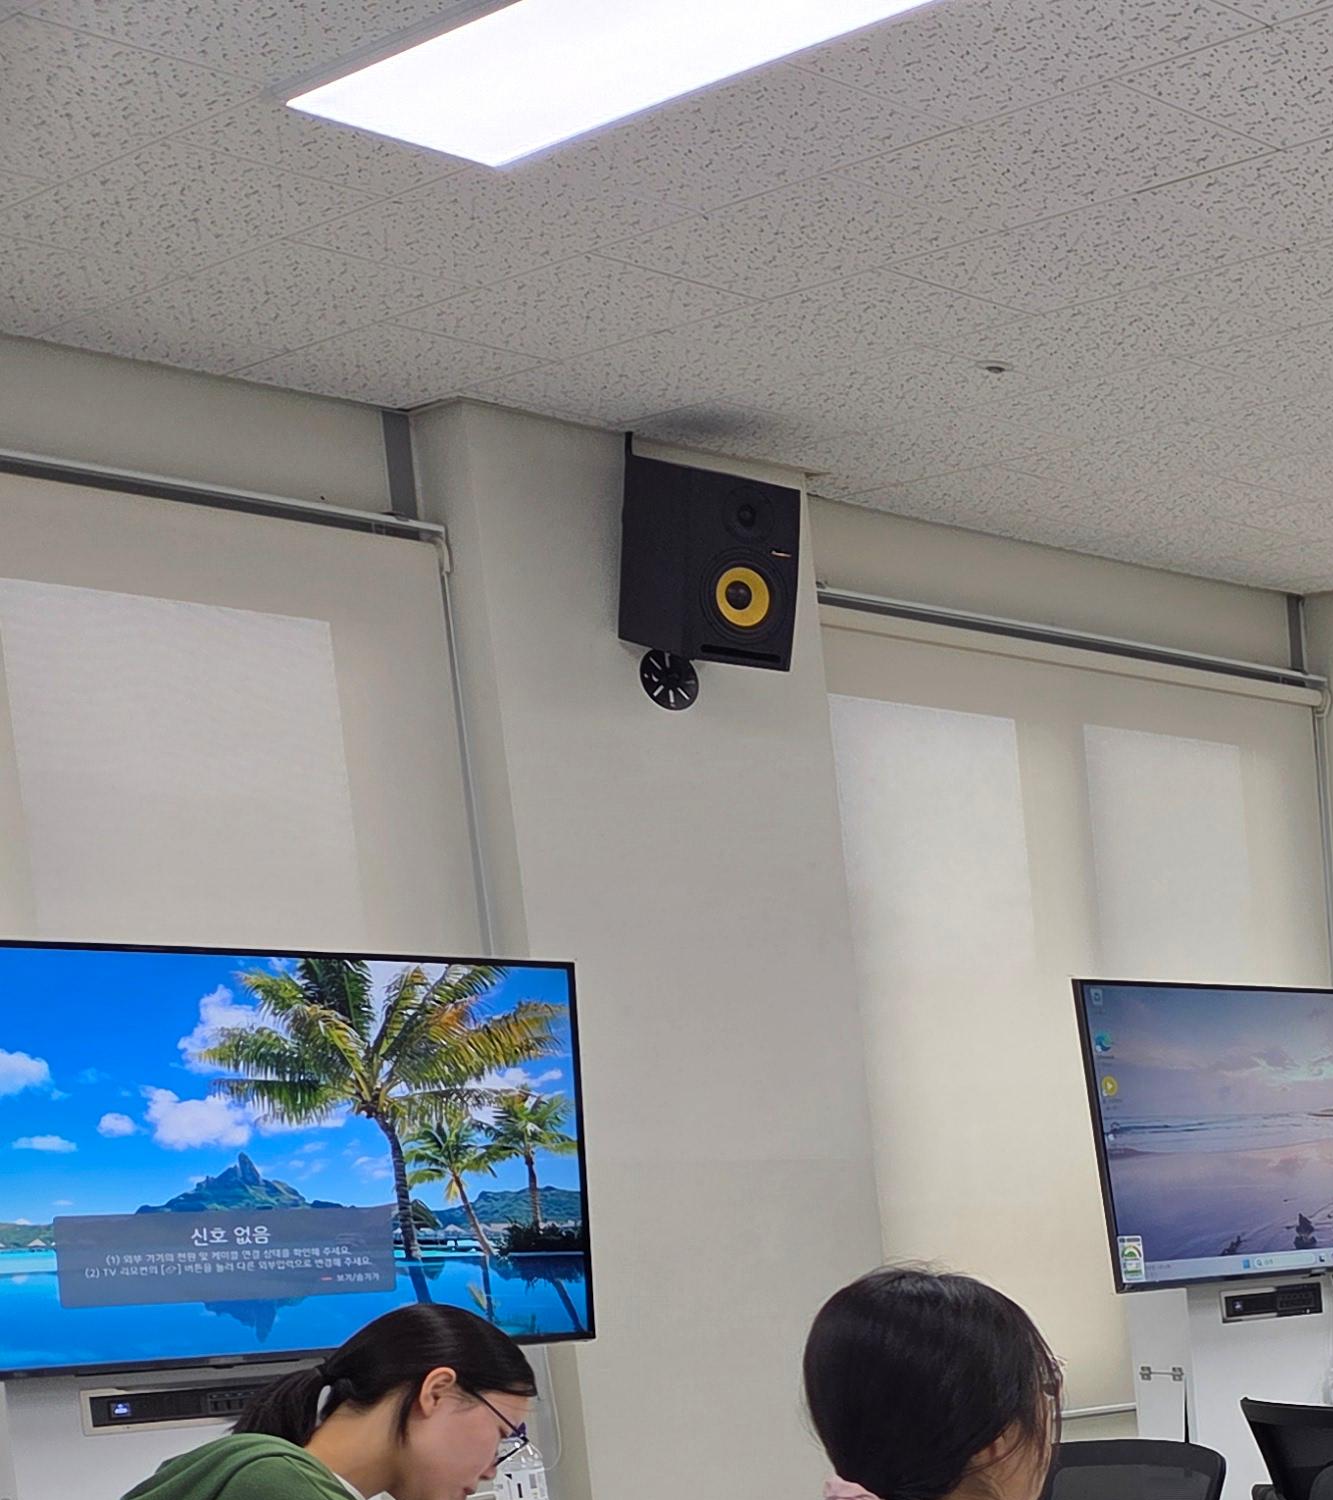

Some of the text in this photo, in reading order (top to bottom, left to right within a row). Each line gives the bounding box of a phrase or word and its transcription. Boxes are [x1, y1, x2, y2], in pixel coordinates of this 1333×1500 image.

[191, 1225, 271, 1246] 신호 없음
[106, 1254, 121, 1266] (1)
[85, 1267, 99, 1279] (2)
[103, 1268, 116, 1277] TV
